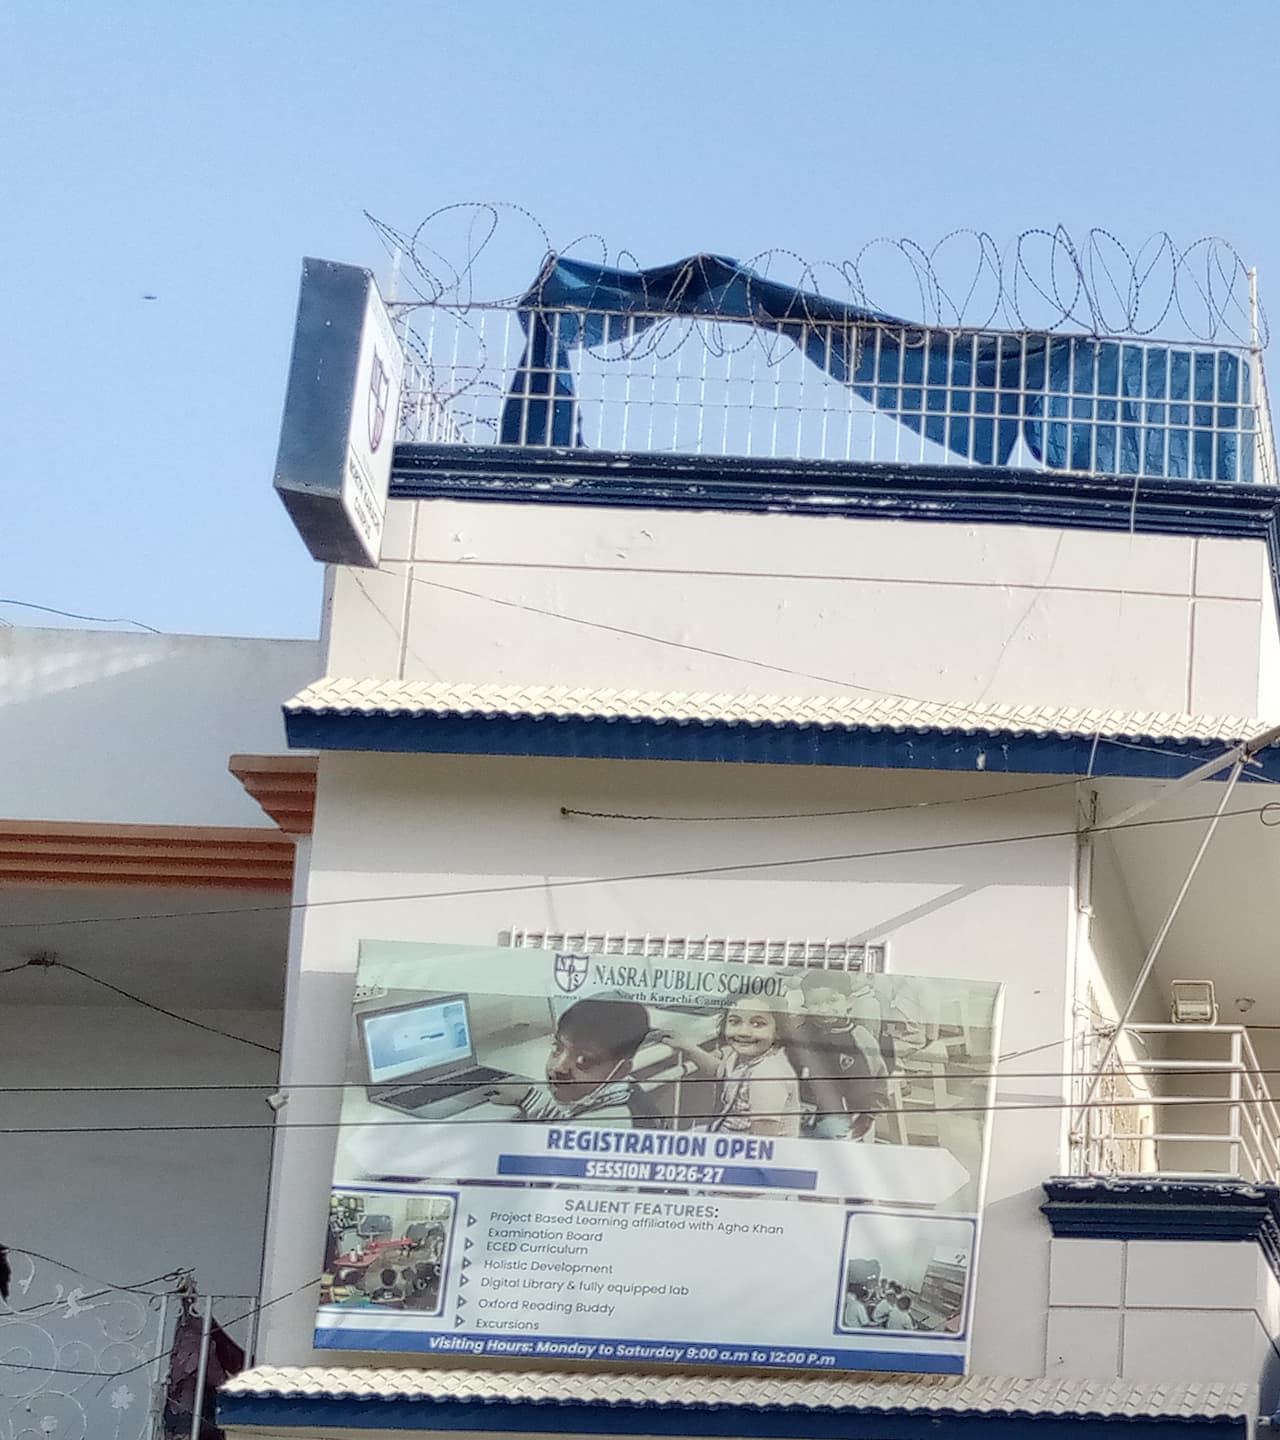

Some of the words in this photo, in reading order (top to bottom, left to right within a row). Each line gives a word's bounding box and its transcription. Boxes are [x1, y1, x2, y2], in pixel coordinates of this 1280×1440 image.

[593, 965, 648, 987] NASRA
[652, 970, 714, 992] PUBLIC
[717, 974, 788, 998] SCHOOL
[547, 1129, 706, 1158] REGISTRATION
[715, 1139, 774, 1161] OPEN
[585, 1160, 650, 1180] SESSION
[654, 1164, 724, 1183] 2026-27
[564, 1199, 631, 1215] SALIENT
[633, 1202, 720, 1219] FEATURES:
[490, 1211, 531, 1226] Project
[535, 1213, 573, 1225] Based
[575, 1215, 628, 1230] Learning
[632, 1216, 686, 1231] affiliated
[689, 1219, 714, 1232] with
[717, 1221, 750, 1236] Agha
[752, 1222, 785, 1235] Khan
[488, 1227, 563, 1242] Examination
[566, 1230, 603, 1242] Board
[486, 1241, 517, 1252] ECED
[519, 1242, 589, 1255] Curriculum
[483, 1259, 528, 1272] Holistic
[530, 1261, 614, 1277] Development
[480, 1277, 520, 1291] Digital
[522, 1278, 565, 1293] Library
[566, 1280, 576, 1291] &
[578, 1280, 605, 1295] fully
[606, 1283, 667, 1297] equipped
[668, 1284, 690, 1297] lab
[478, 1297, 519, 1310] Oxford
[521, 1299, 573, 1315] Reading
[575, 1301, 616, 1317] Buddy
[475, 1318, 540, 1331] Excursions
[428, 1336, 485, 1354] Visiting
[486, 1338, 534, 1353] Hours:
[536, 1341, 597, 1359] Monday
[599, 1343, 613, 1356] to
[615, 1343, 685, 1362] Saturday
[686, 1347, 718, 1361] 9:00
[719, 1351, 748, 1363] a.m
[750, 1350, 767, 1363] to
[768, 1350, 805, 1365] 12:00
[806, 1352, 836, 1367] P.m
